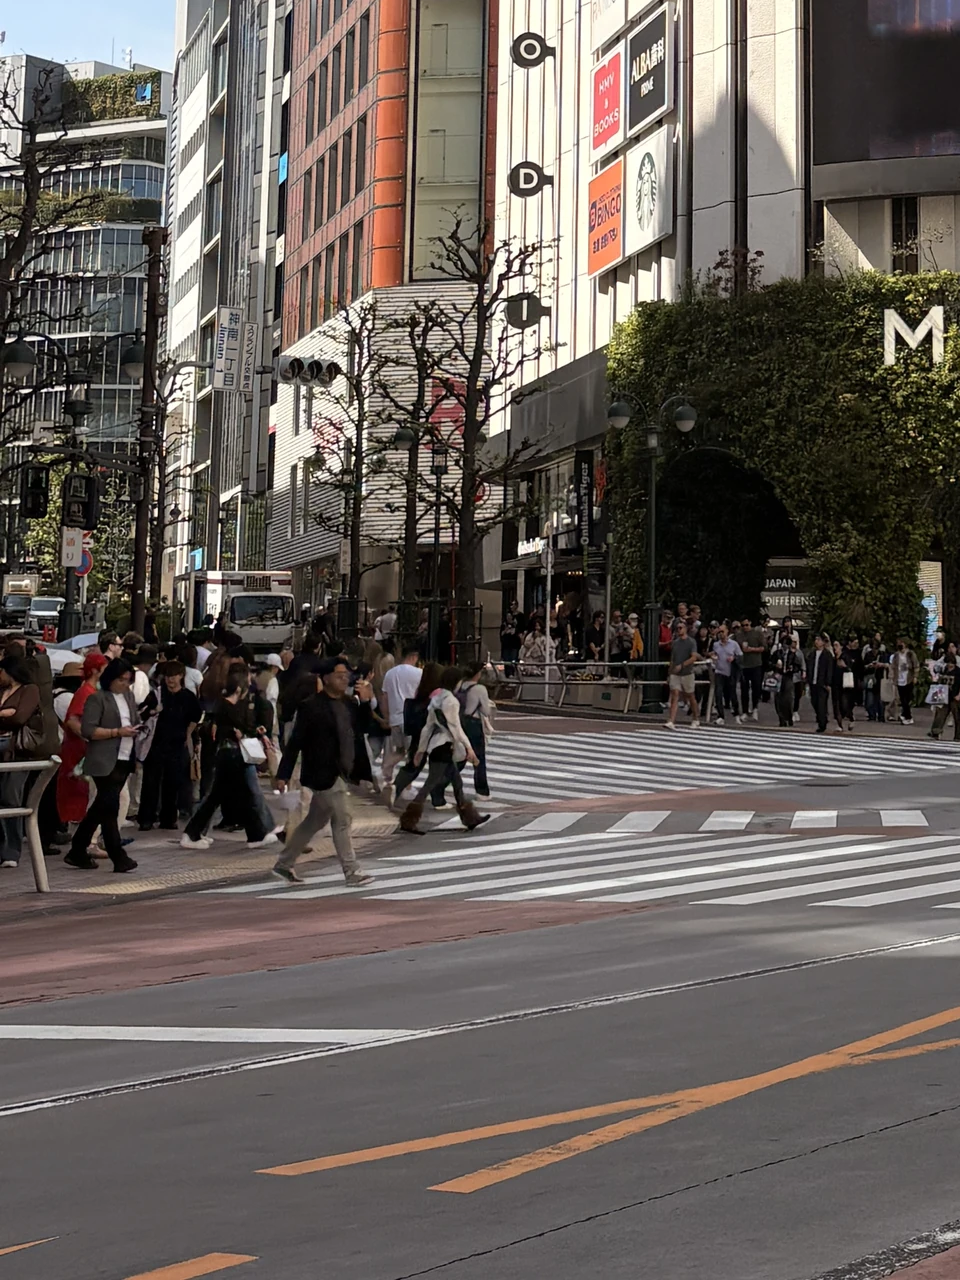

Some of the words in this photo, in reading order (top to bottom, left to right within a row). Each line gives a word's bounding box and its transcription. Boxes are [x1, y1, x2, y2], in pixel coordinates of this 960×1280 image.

[599, 72, 615, 95] HMV
[594, 108, 619, 138] BOOKS
[597, 193, 621, 227] BINGO
[217, 323, 227, 359] Jinnan
[765, 579, 796, 589] JAPAN
[765, 595, 817, 606] DIFFERENC
